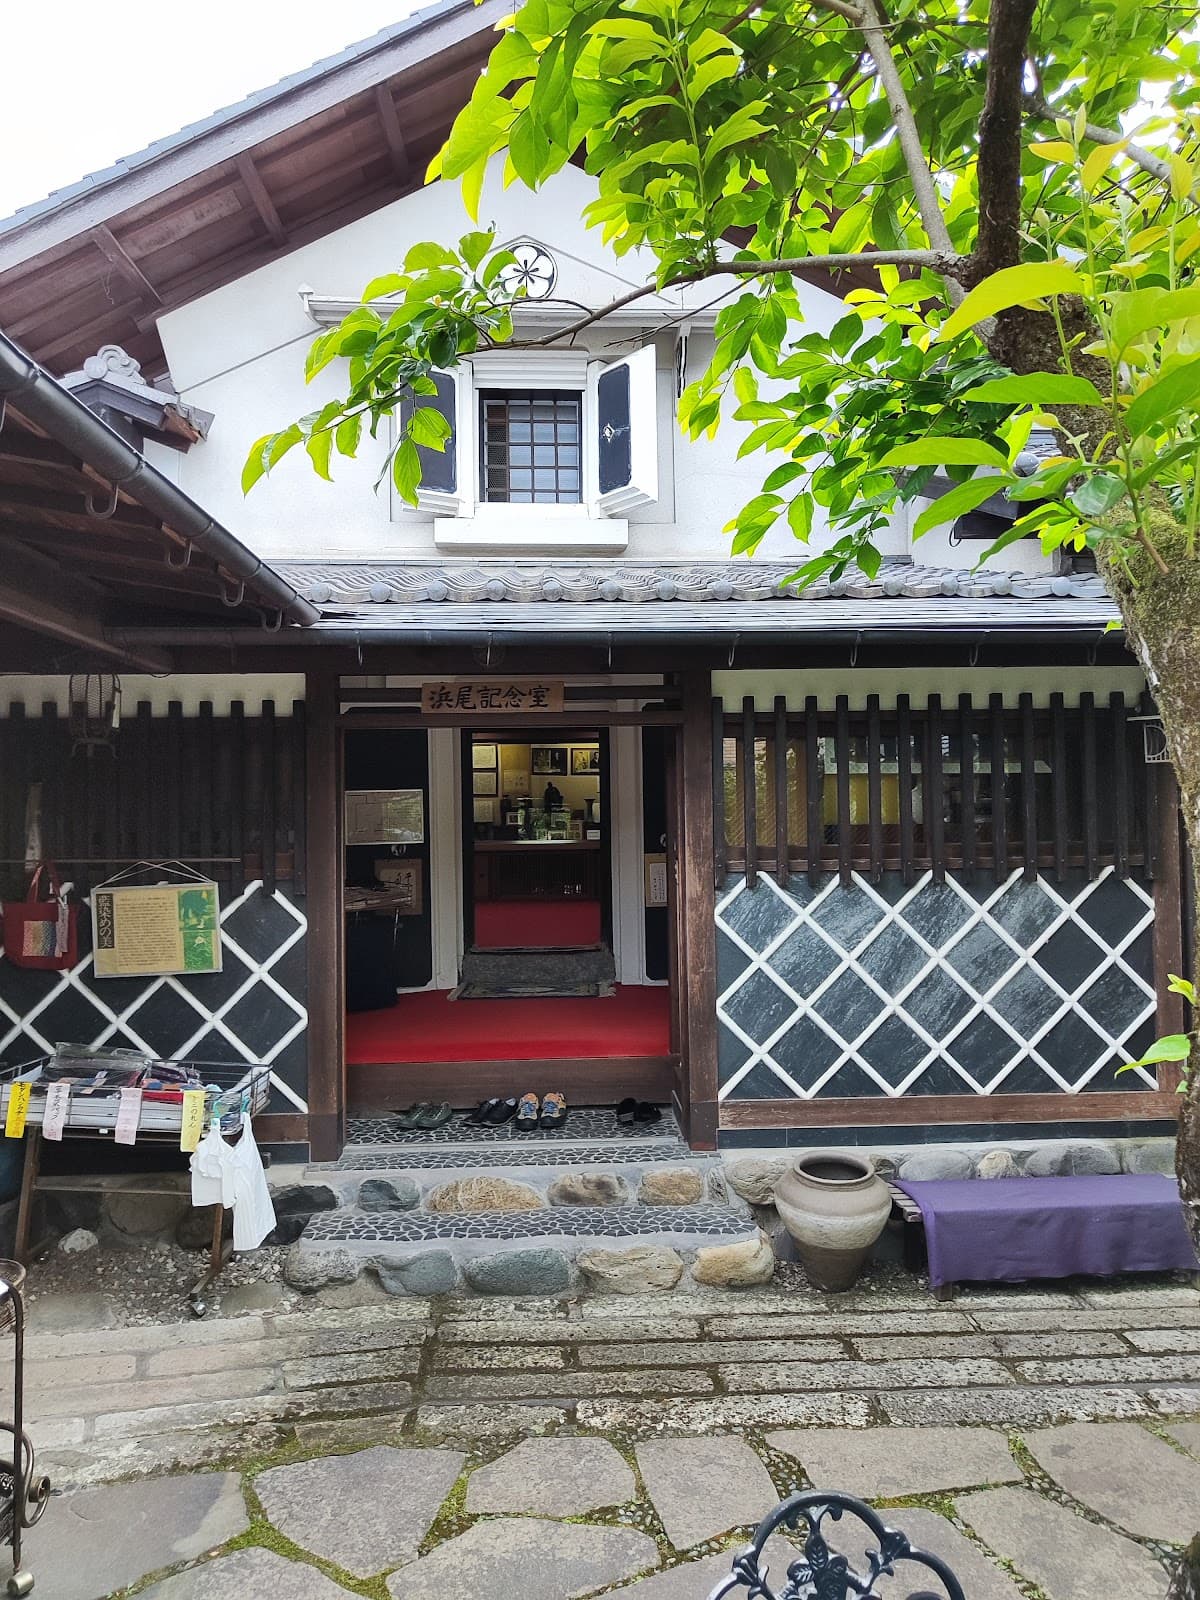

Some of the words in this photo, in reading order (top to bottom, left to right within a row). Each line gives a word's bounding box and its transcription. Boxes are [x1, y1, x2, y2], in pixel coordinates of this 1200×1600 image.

[429, 685, 551, 710] 浜尾記念室
[98, 894, 113, 949] 藍染めの美
